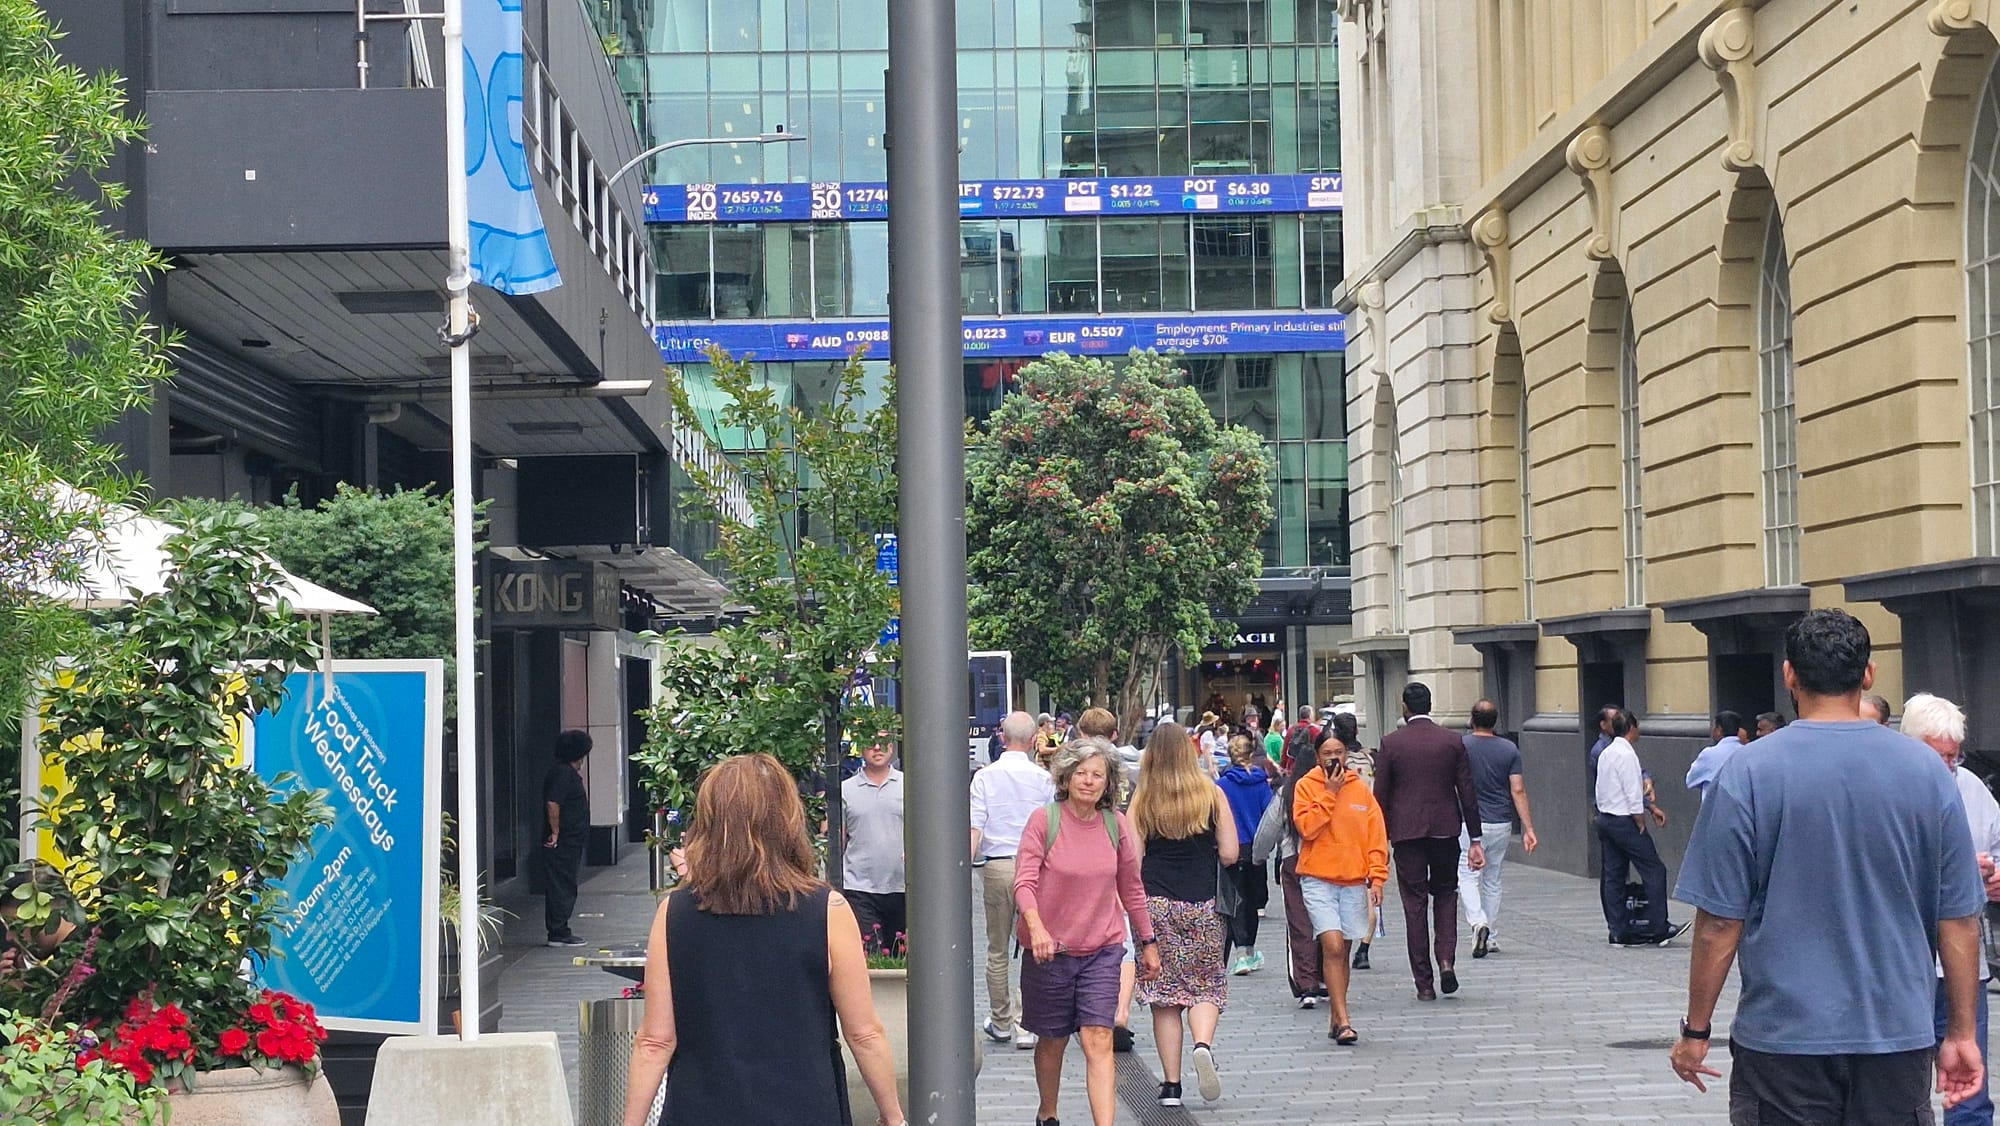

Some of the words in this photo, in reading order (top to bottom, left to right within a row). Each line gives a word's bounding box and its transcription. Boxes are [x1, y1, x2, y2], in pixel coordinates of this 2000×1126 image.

[1067, 181, 1098, 195] PCT
[1184, 179, 1217, 193] POT
[1228, 183, 1270, 195] $6.30
[1311, 177, 1341, 190] SPY
[722, 191, 783, 204] 7659.76
[993, 186, 1044, 200] $72.73
[1110, 184, 1153, 198] $1.22
[687, 192, 717, 211] 20
[811, 190, 842, 210] 50
[687, 211, 718, 220] INDEX
[811, 209, 842, 219] INDEX
[963, 329, 1007, 339] 0.8223
[1081, 327, 1124, 337] 0.5507
[1156, 324, 1228, 336] Employment:
[1230, 322, 1270, 334] Primary
[1328, 320, 1346, 331] still
[812, 337, 842, 348] AUD
[846, 331, 889, 341] 0.9088
[1050, 332, 1076, 343] EUR
[1156, 336, 1199, 347] average
[1202, 334, 1229, 346] $70k
[494, 573, 582, 612] KONG
[1208, 633, 1276, 643] ACH
[317, 698, 360, 753] Food
[357, 746, 397, 812] Truck
[305, 712, 394, 851] Wednesdays
